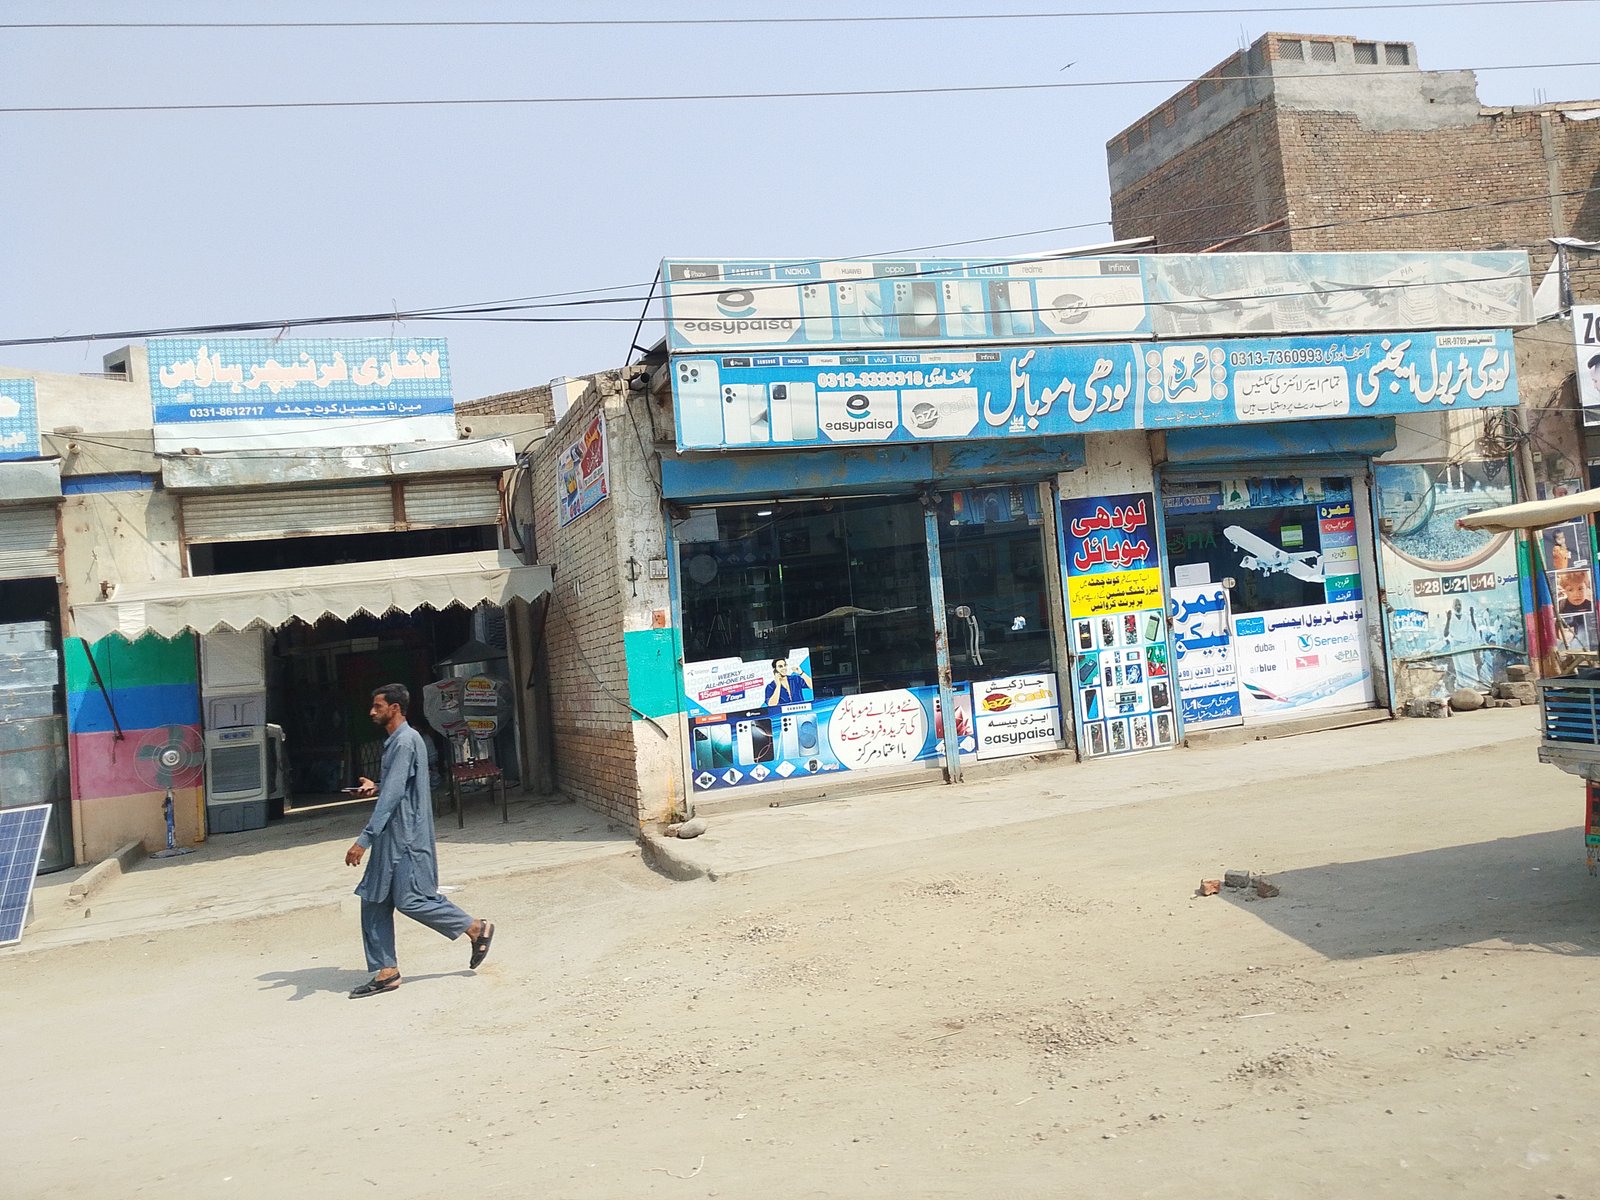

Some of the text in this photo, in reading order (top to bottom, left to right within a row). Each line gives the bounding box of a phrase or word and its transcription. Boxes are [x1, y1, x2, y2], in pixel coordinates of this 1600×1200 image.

[785, 268, 811, 276] NOKIA
[684, 317, 793, 334] easypaisa
[1230, 348, 1323, 366] 0313-7360993
[159, 344, 441, 394] لاشاری فرنیچر ہاؤس
[1355, 338, 1416, 407] ایجنسی
[1414, 347, 1470, 405] ٹریول
[983, 350, 1132, 430] لودھی موبائل
[1270, 374, 1284, 394] کی
[1321, 375, 1341, 394] تمام
[189, 406, 265, 418] 0331-8612717
[338, 402, 386, 414] تحصیل
[1257, 401, 1287, 415] دستیاب
[1314, 398, 1343, 411] مناسب
[825, 418, 893, 433] easypaisa
[1070, 498, 1148, 537] لودھی
[1321, 503, 1351, 518] عمرہ
[1186, 532, 1218, 550] PIA
[1074, 535, 1151, 572] موبائل
[1424, 580, 1440, 594] 28
[1454, 577, 1468, 591] 21
[1481, 577, 1495, 589] 14
[1267, 614, 1305, 633] ایجنسی
[1305, 609, 1333, 628] ٹریول
[1332, 608, 1363, 625] لودھی
[1343, 649, 1360, 661] PIA
[705, 676, 740, 690] ALL-IN-ONE
[740, 672, 756, 682] PLUS
[717, 670, 743, 681] WEEKLY
[985, 679, 1045, 694] جاز کیش
[981, 689, 1054, 712] Jazz Cash
[905, 713, 920, 736] کی
[987, 712, 1049, 729] ایزی پیسہ
[840, 725, 851, 742] کا
[847, 720, 883, 741] فروخت
[984, 726, 1056, 745] easypaisa
[855, 741, 878, 765] مرکز
